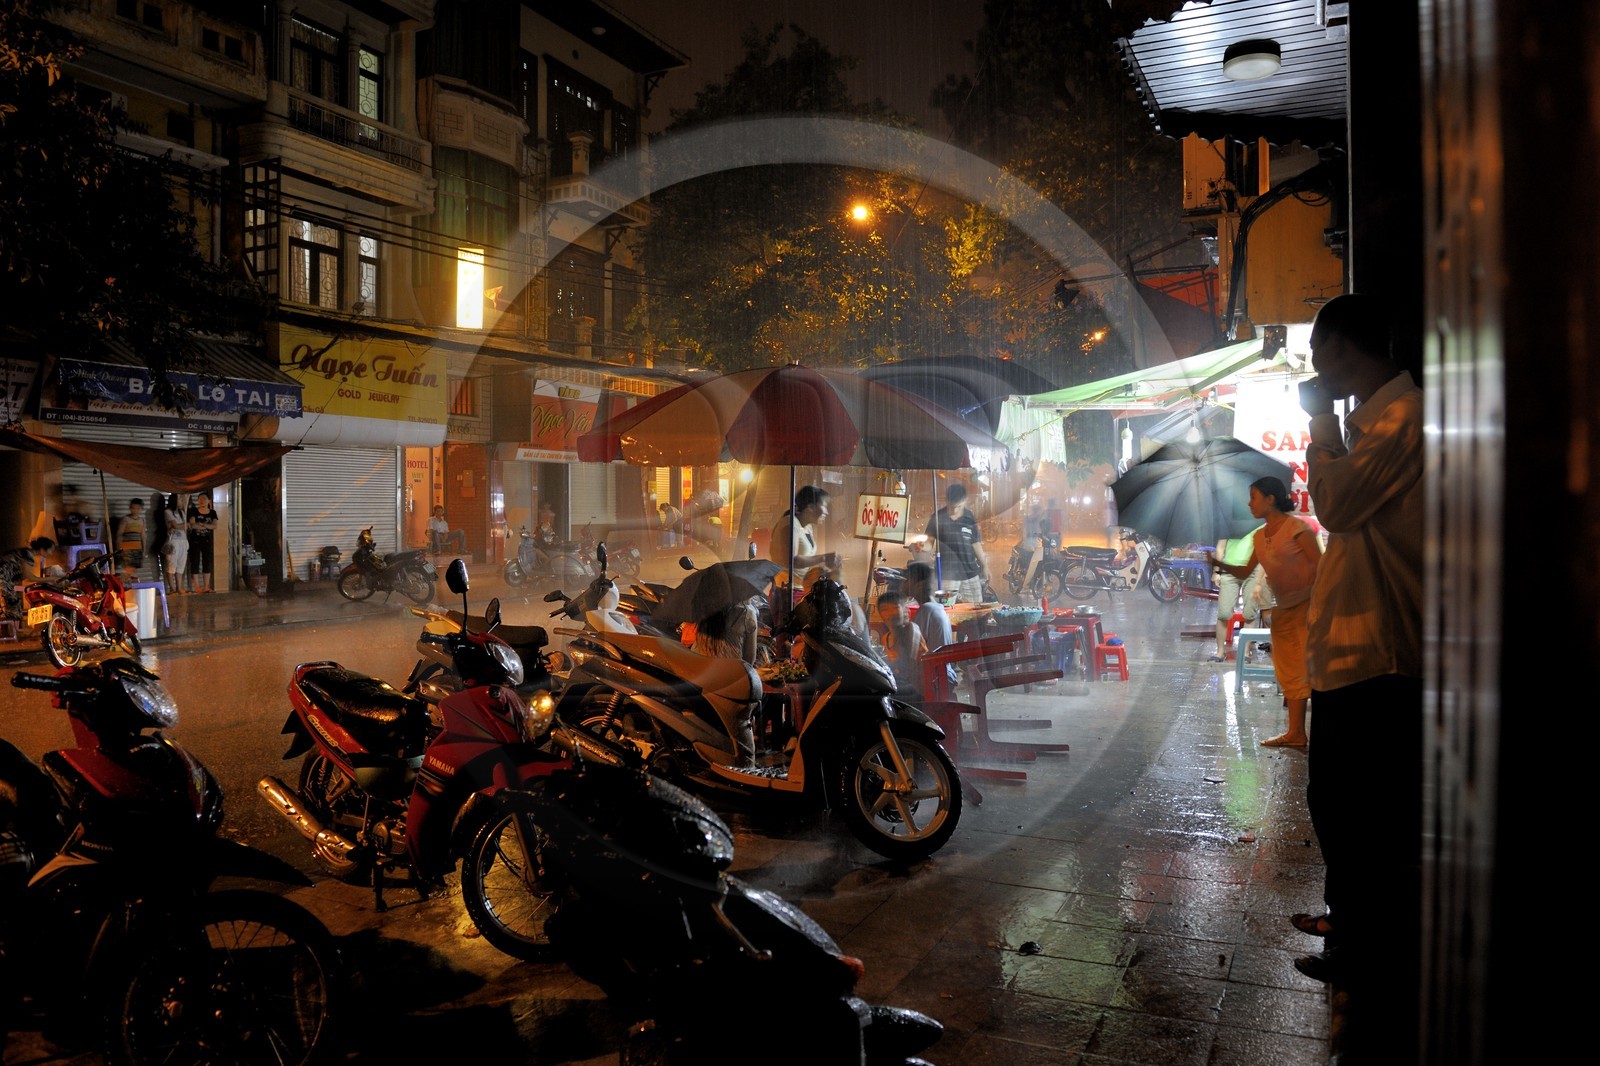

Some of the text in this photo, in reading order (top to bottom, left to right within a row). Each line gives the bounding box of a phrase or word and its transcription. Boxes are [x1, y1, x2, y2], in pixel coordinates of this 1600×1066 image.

[291, 344, 439, 388] Ngọc Tuấn
[235, 388, 270, 406] TAI
[337, 388, 362, 399] GOLD
[407, 460, 429, 469] HOTEL
[861, 500, 874, 526] ỐC
[428, 754, 455, 776] YAMAHA
